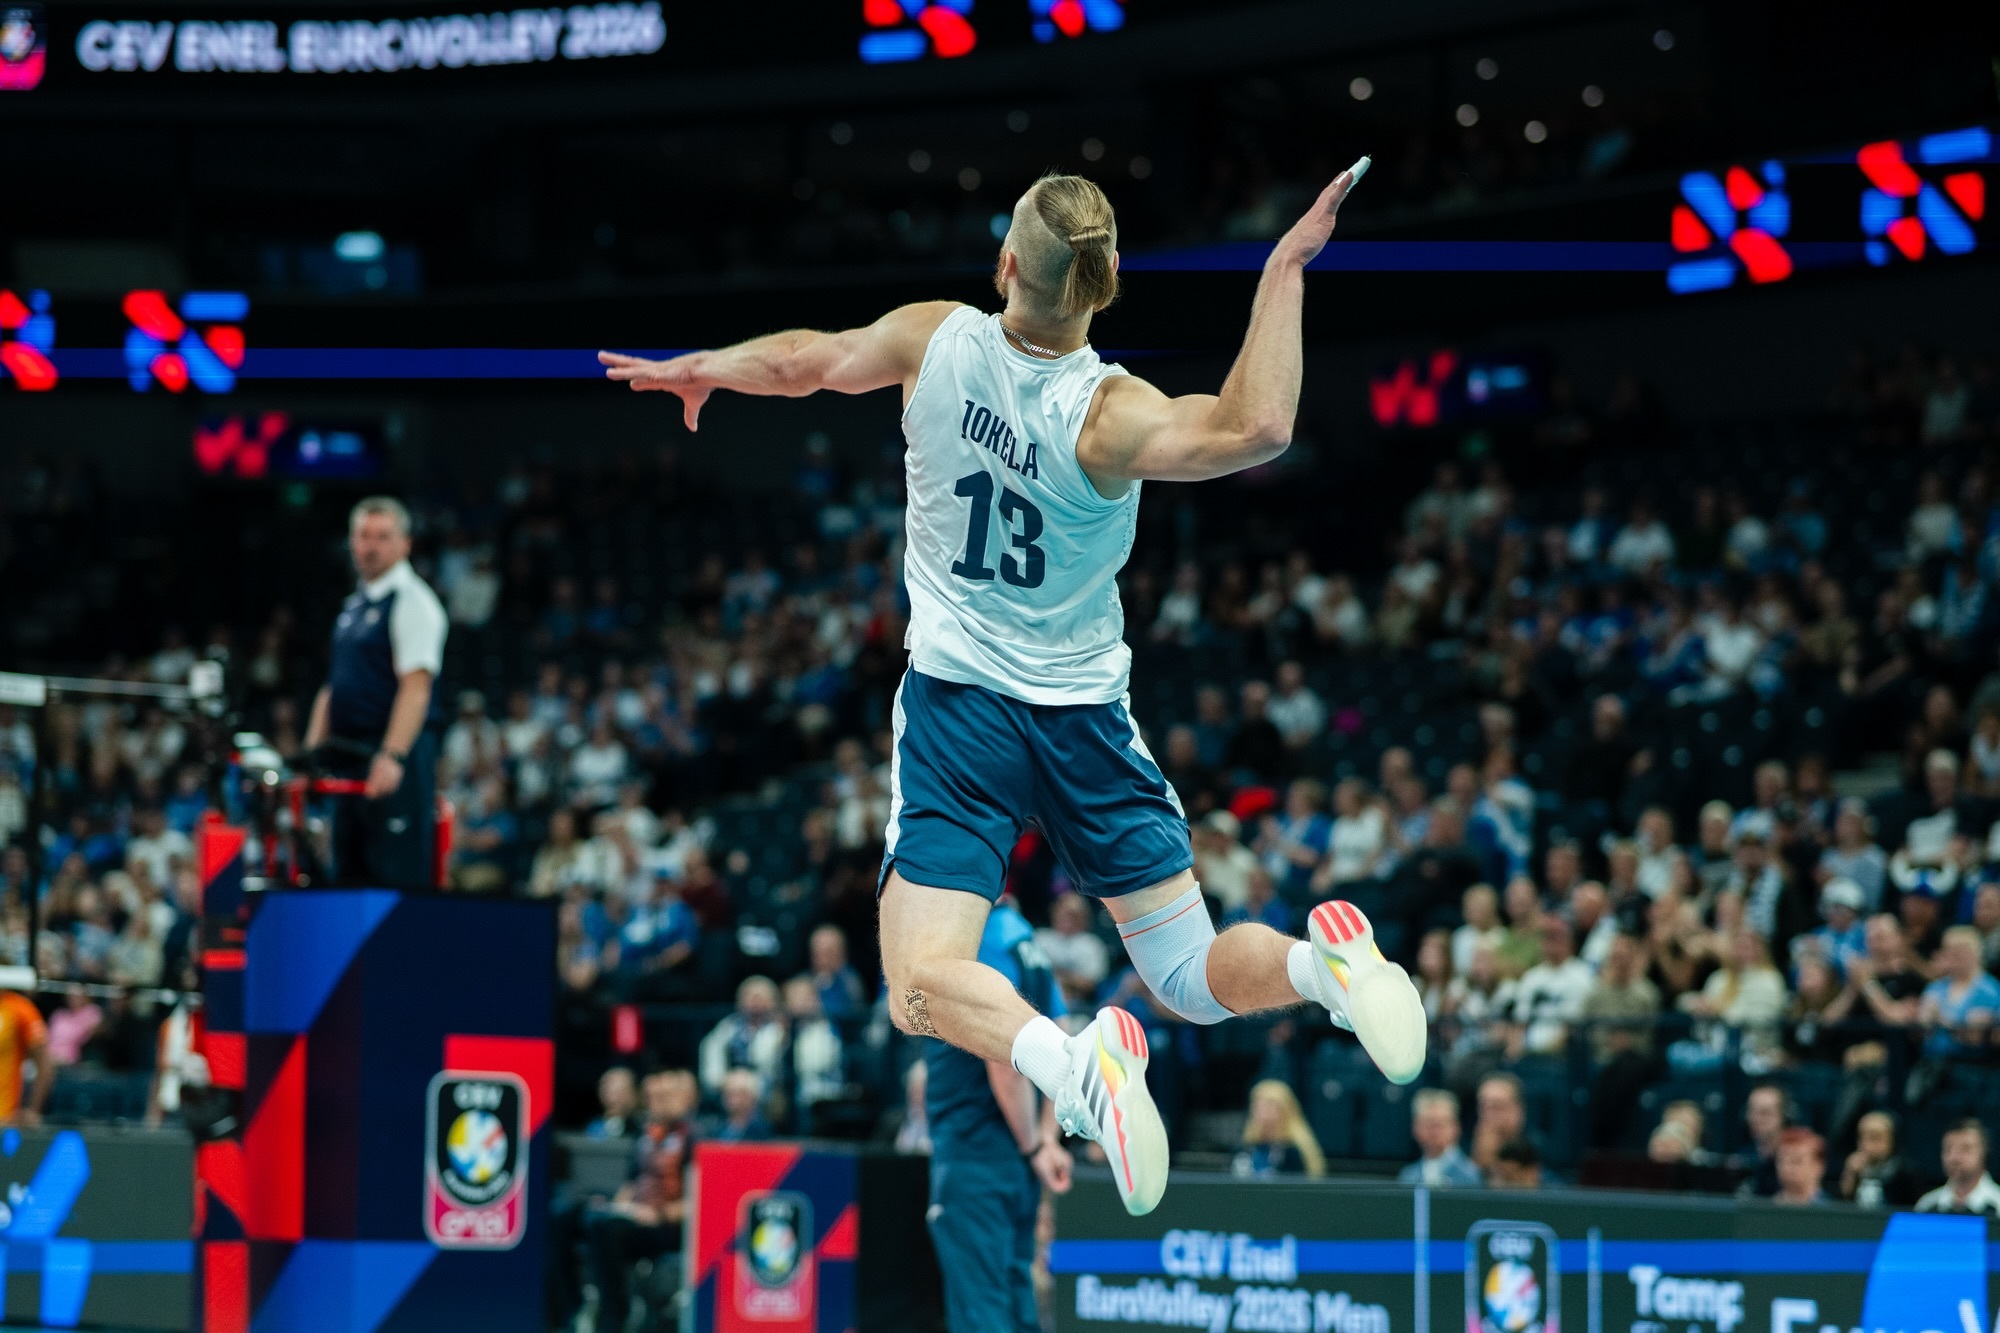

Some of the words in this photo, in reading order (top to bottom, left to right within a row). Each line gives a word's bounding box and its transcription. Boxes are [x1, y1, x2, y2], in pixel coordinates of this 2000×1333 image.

[77, 21, 173, 71] CEV
[176, 21, 286, 72] ENEL
[289, 9, 563, 72] EUROVOLLEY
[563, 2, 666, 59] 2026
[960, 399, 1039, 480] JOKELA
[950, 470, 1046, 589] 13
[453, 1082, 503, 1110] CEV
[1160, 1228, 1226, 1279] CEV
[1226, 1232, 1298, 1283] Enel
[1076, 1273, 1232, 1333] EuroVolley
[1313, 1289, 1391, 1333] Men
